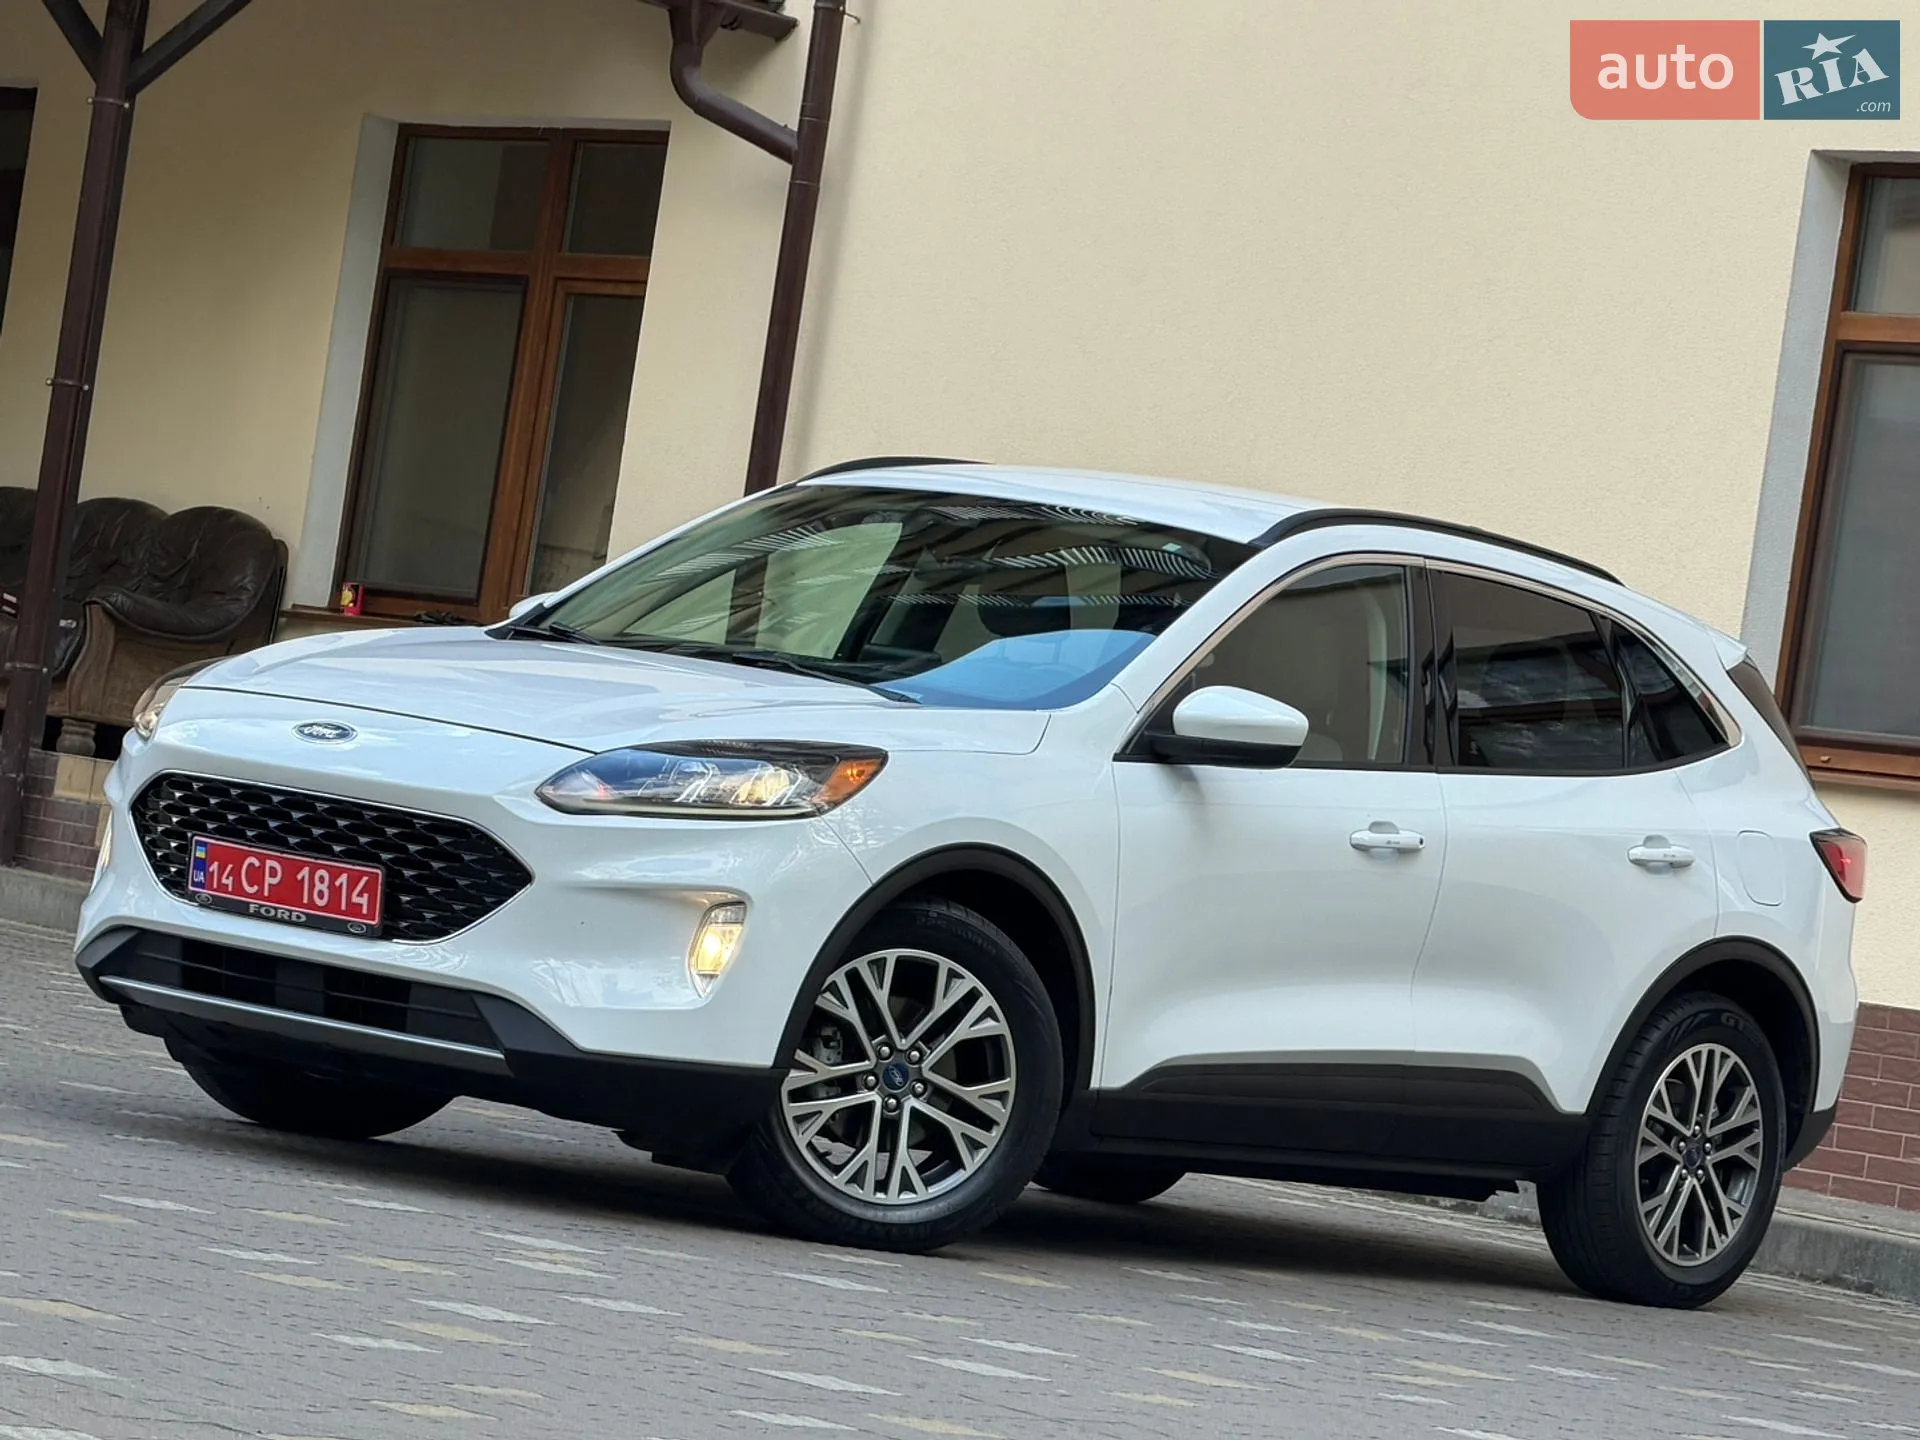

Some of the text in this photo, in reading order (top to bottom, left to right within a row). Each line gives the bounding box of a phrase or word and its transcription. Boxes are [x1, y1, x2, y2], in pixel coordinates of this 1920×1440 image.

[193, 870, 205, 883] UA
[208, 856, 369, 914] 14 CP 1814
[248, 904, 307, 922] FORD
